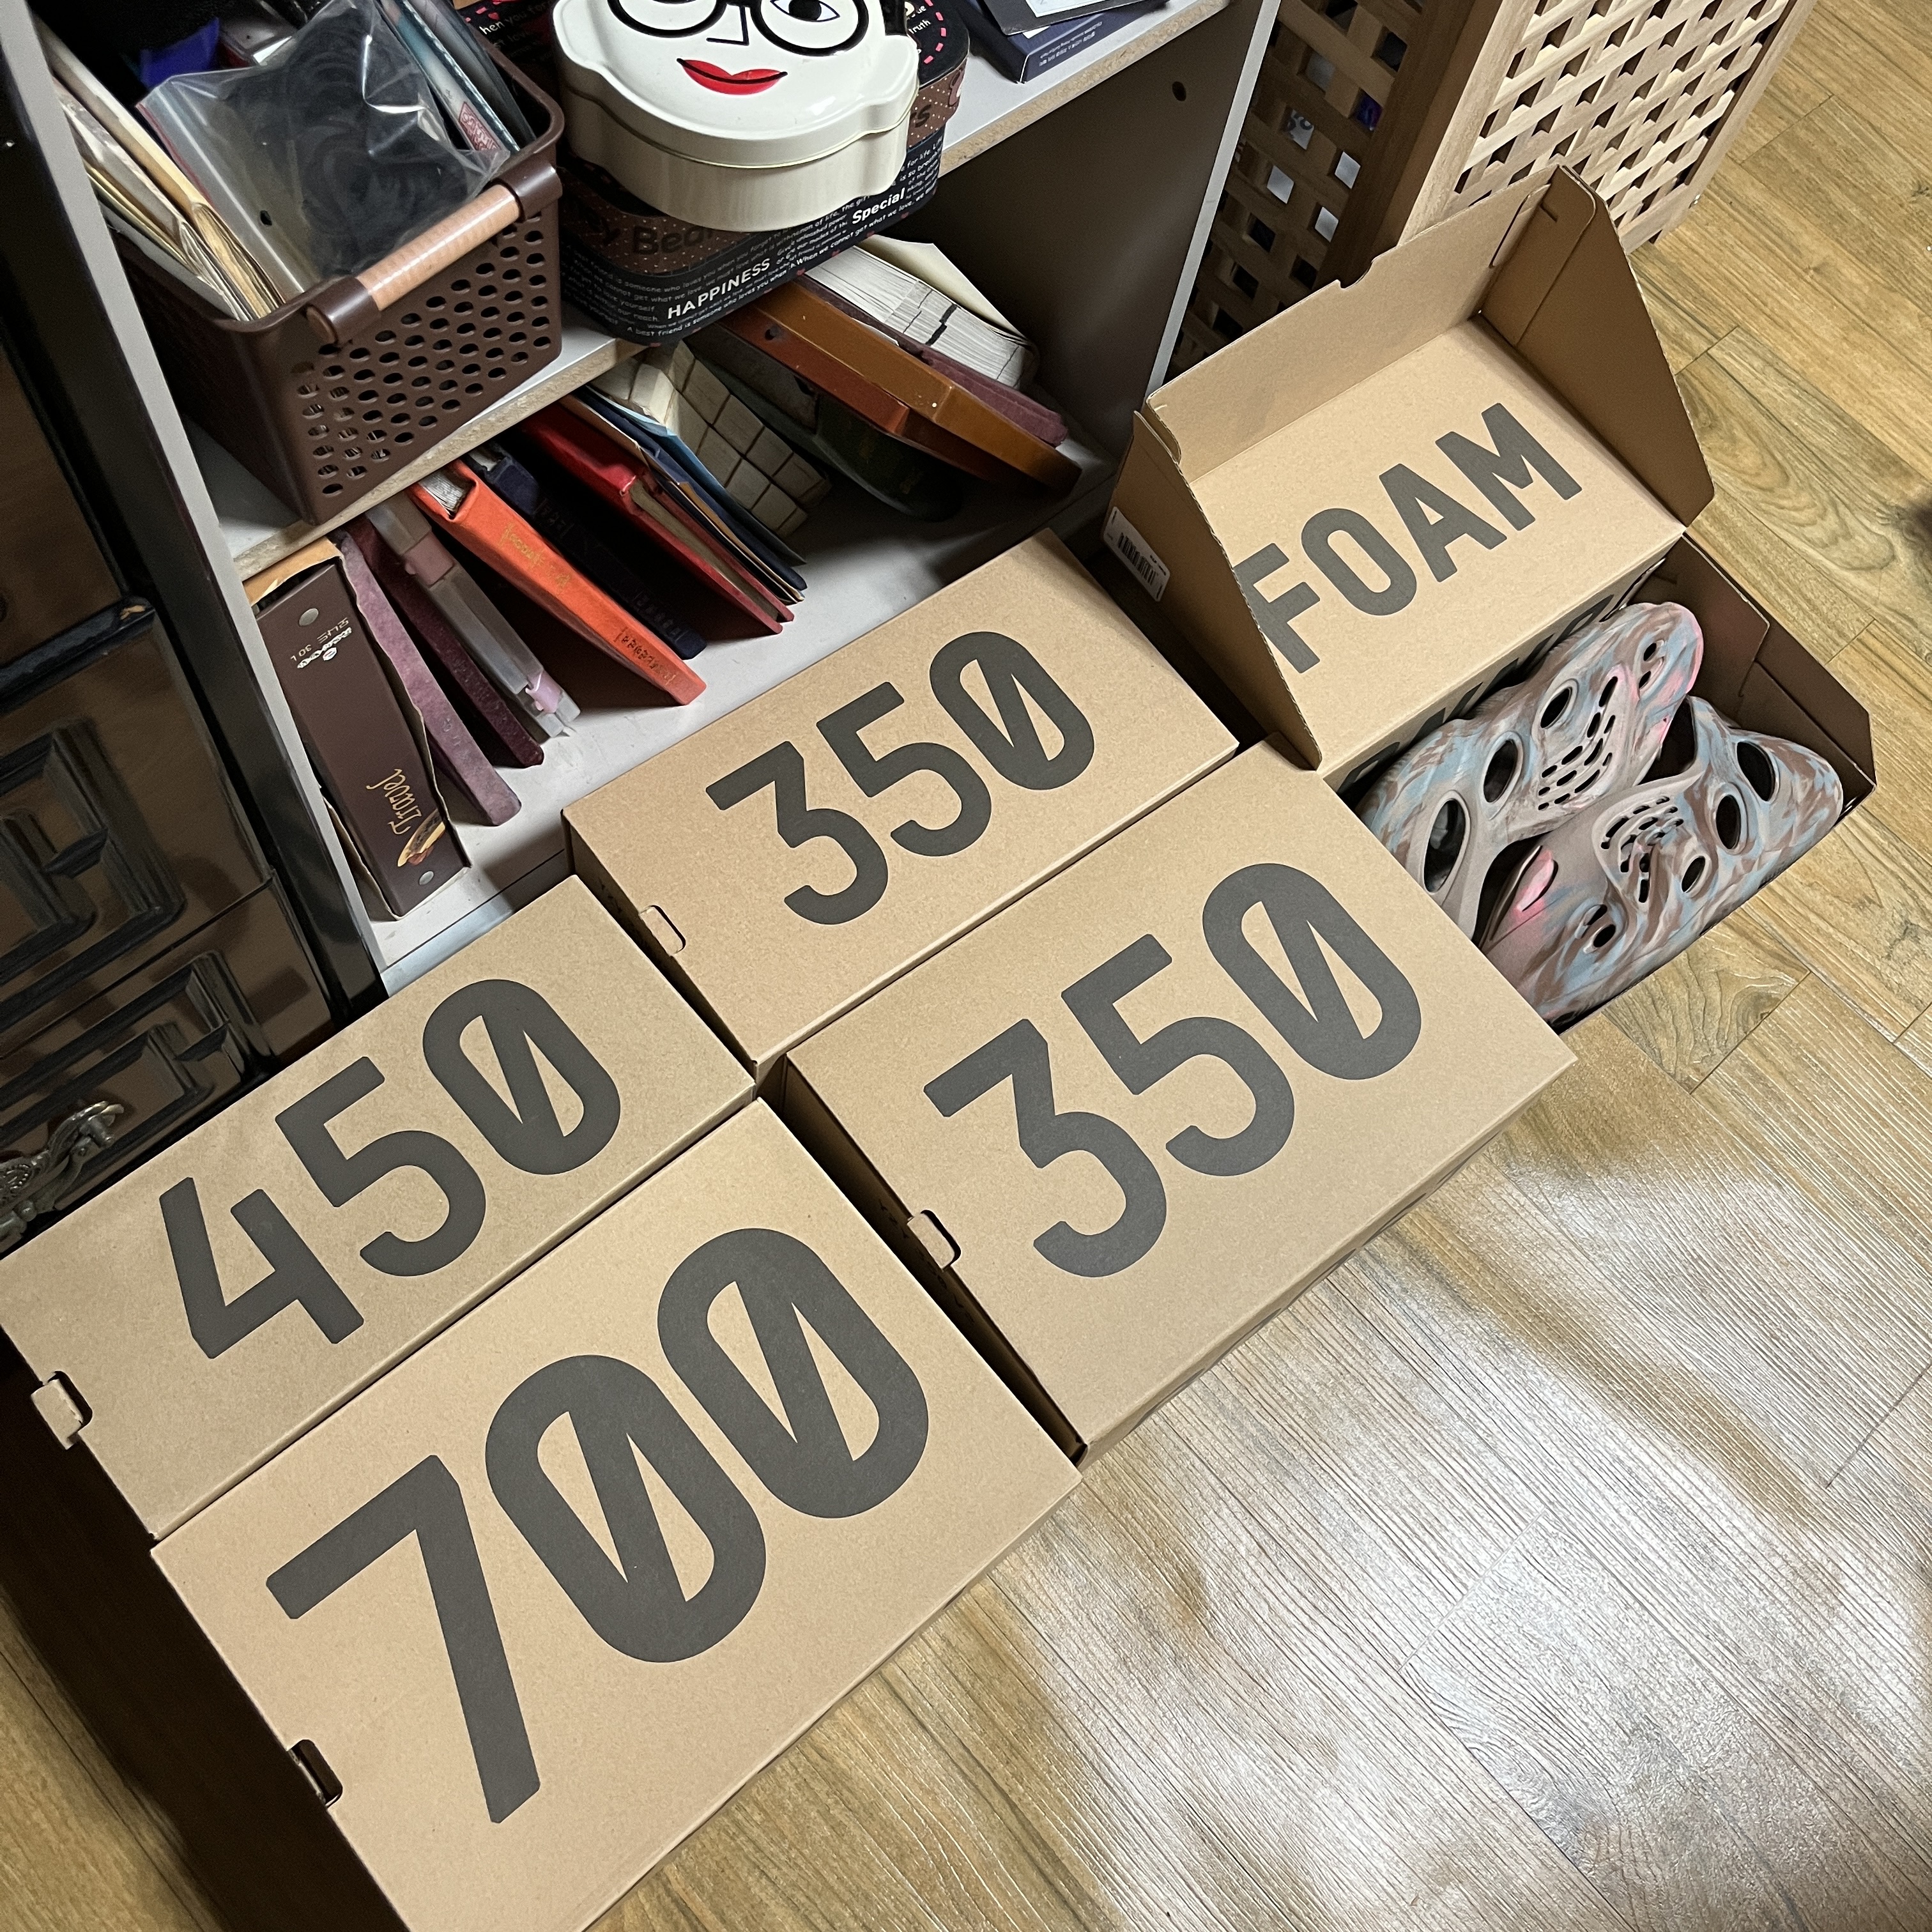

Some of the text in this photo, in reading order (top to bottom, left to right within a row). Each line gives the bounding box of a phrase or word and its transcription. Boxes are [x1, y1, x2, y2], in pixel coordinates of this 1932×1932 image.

[479, 21, 505, 35] hen
[852, 187, 906, 224] Special
[667, 257, 770, 319] HAPPINESS
[795, 252, 818, 265] When
[635, 327, 656, 337] best
[657, 324, 684, 337] friend
[1233, 403, 1581, 673] FOAM
[298, 644, 312, 657] 30
[365, 768, 422, 835] Travel
[709, 632, 1093, 924] 350
[925, 864, 1422, 1278] 350
[161, 981, 620, 1358] 450
[268, 1228, 928, 1822] 700
